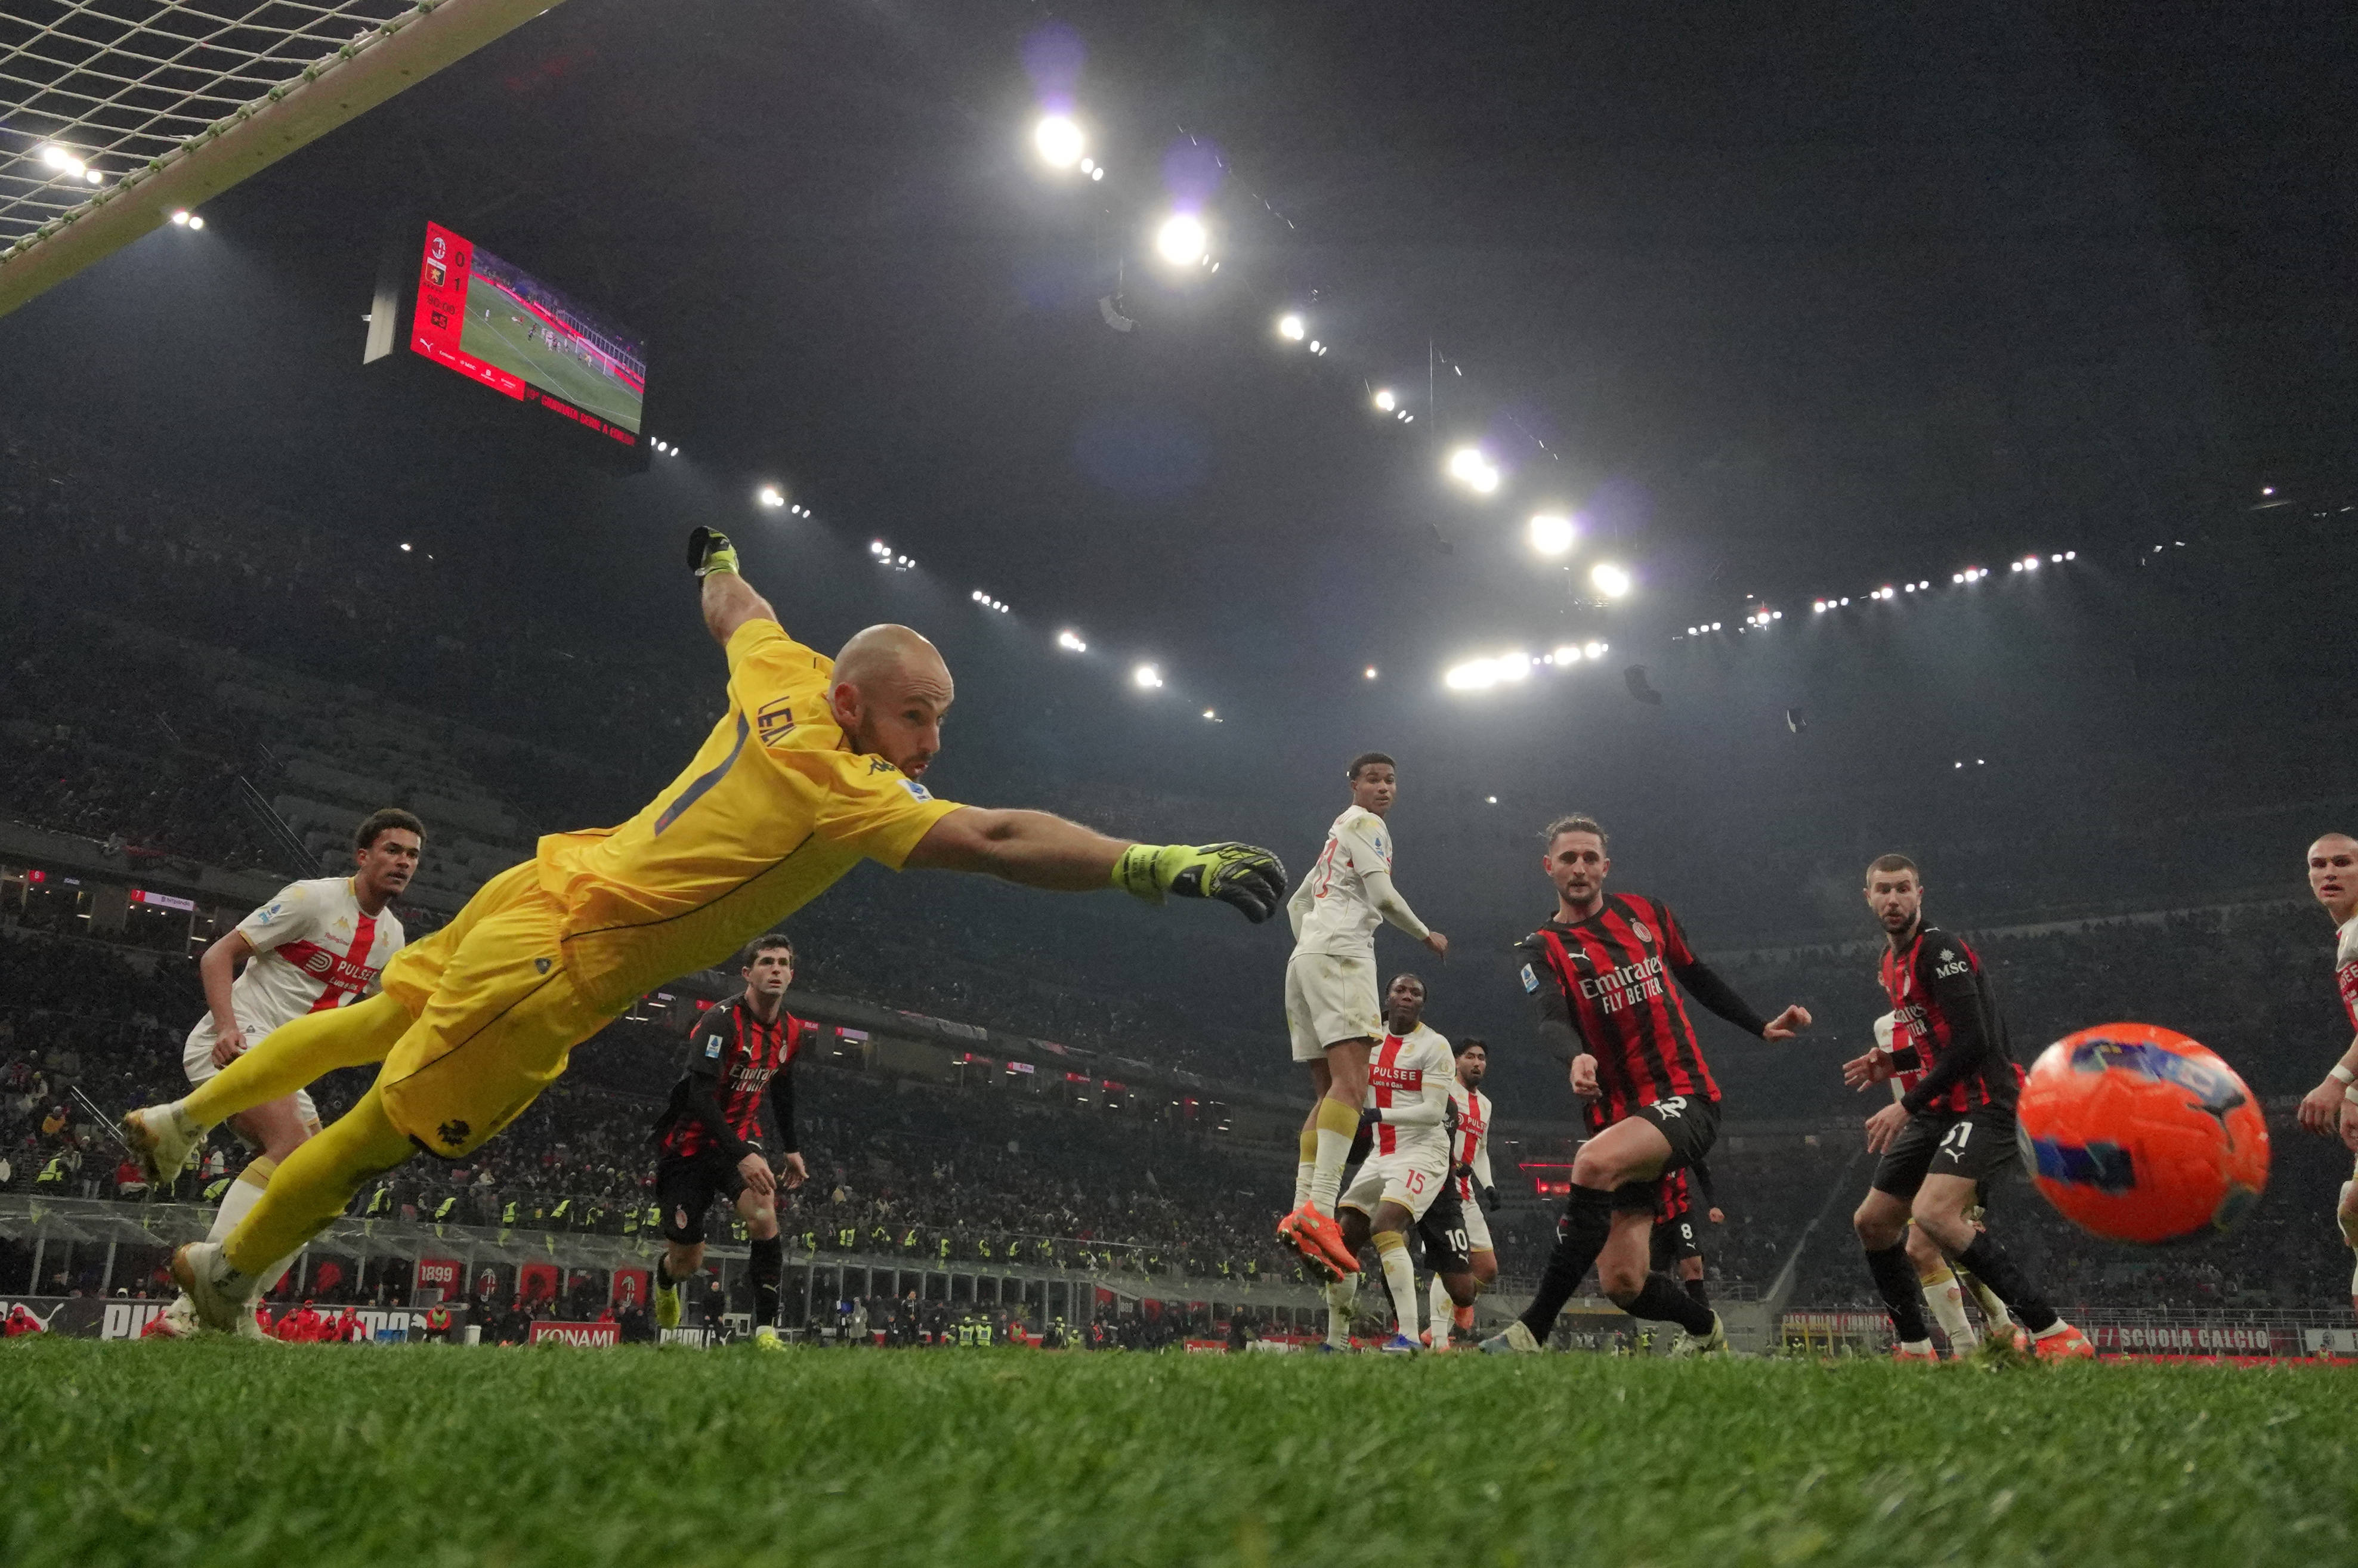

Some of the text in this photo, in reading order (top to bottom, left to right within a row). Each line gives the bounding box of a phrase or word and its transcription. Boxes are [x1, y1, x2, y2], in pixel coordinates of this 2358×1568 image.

[455, 251, 465, 268] 0
[455, 277, 461, 292] 1
[1578, 955, 1663, 1000] Emirates
[1936, 961, 1968, 979] MSC
[1602, 976, 1664, 1015] FLY BETTER
[1373, 1066, 1417, 1081] PULSEE
[1391, 1081, 1404, 1089] Gas
[1405, 1168, 1426, 1195] 15
[1445, 1228, 1468, 1252] 10
[1681, 1223, 1693, 1239] 8
[422, 1266, 453, 1282] 1899
[536, 1329, 614, 1347] KONAMI
[2120, 1329, 2193, 1347] SCUOLA
[2199, 1329, 2267, 1349] CALCIO
